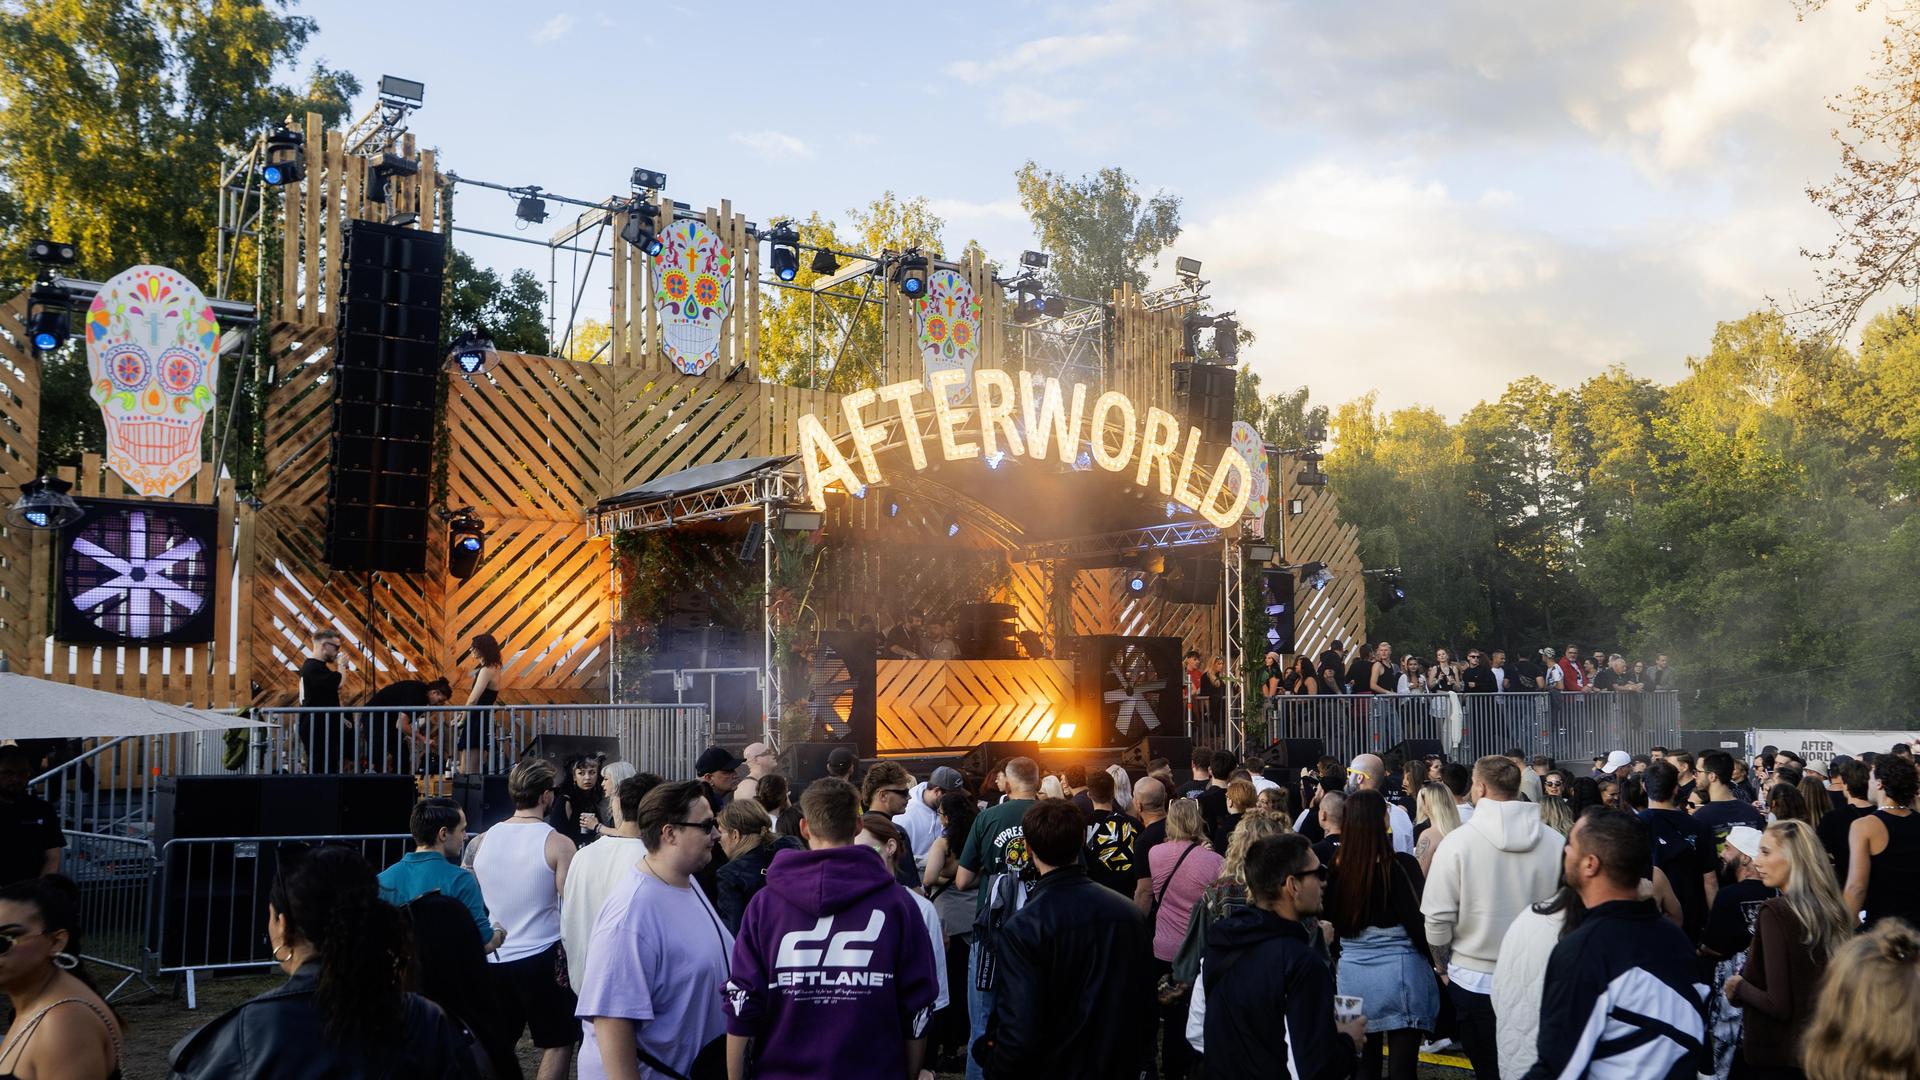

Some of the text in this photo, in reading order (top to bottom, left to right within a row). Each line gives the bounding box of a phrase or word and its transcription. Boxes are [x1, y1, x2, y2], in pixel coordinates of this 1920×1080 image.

[797, 368, 1252, 529] AFTERWORLD
[1801, 741, 1833, 751] AFTER
[1798, 751, 1837, 762] WORLD
